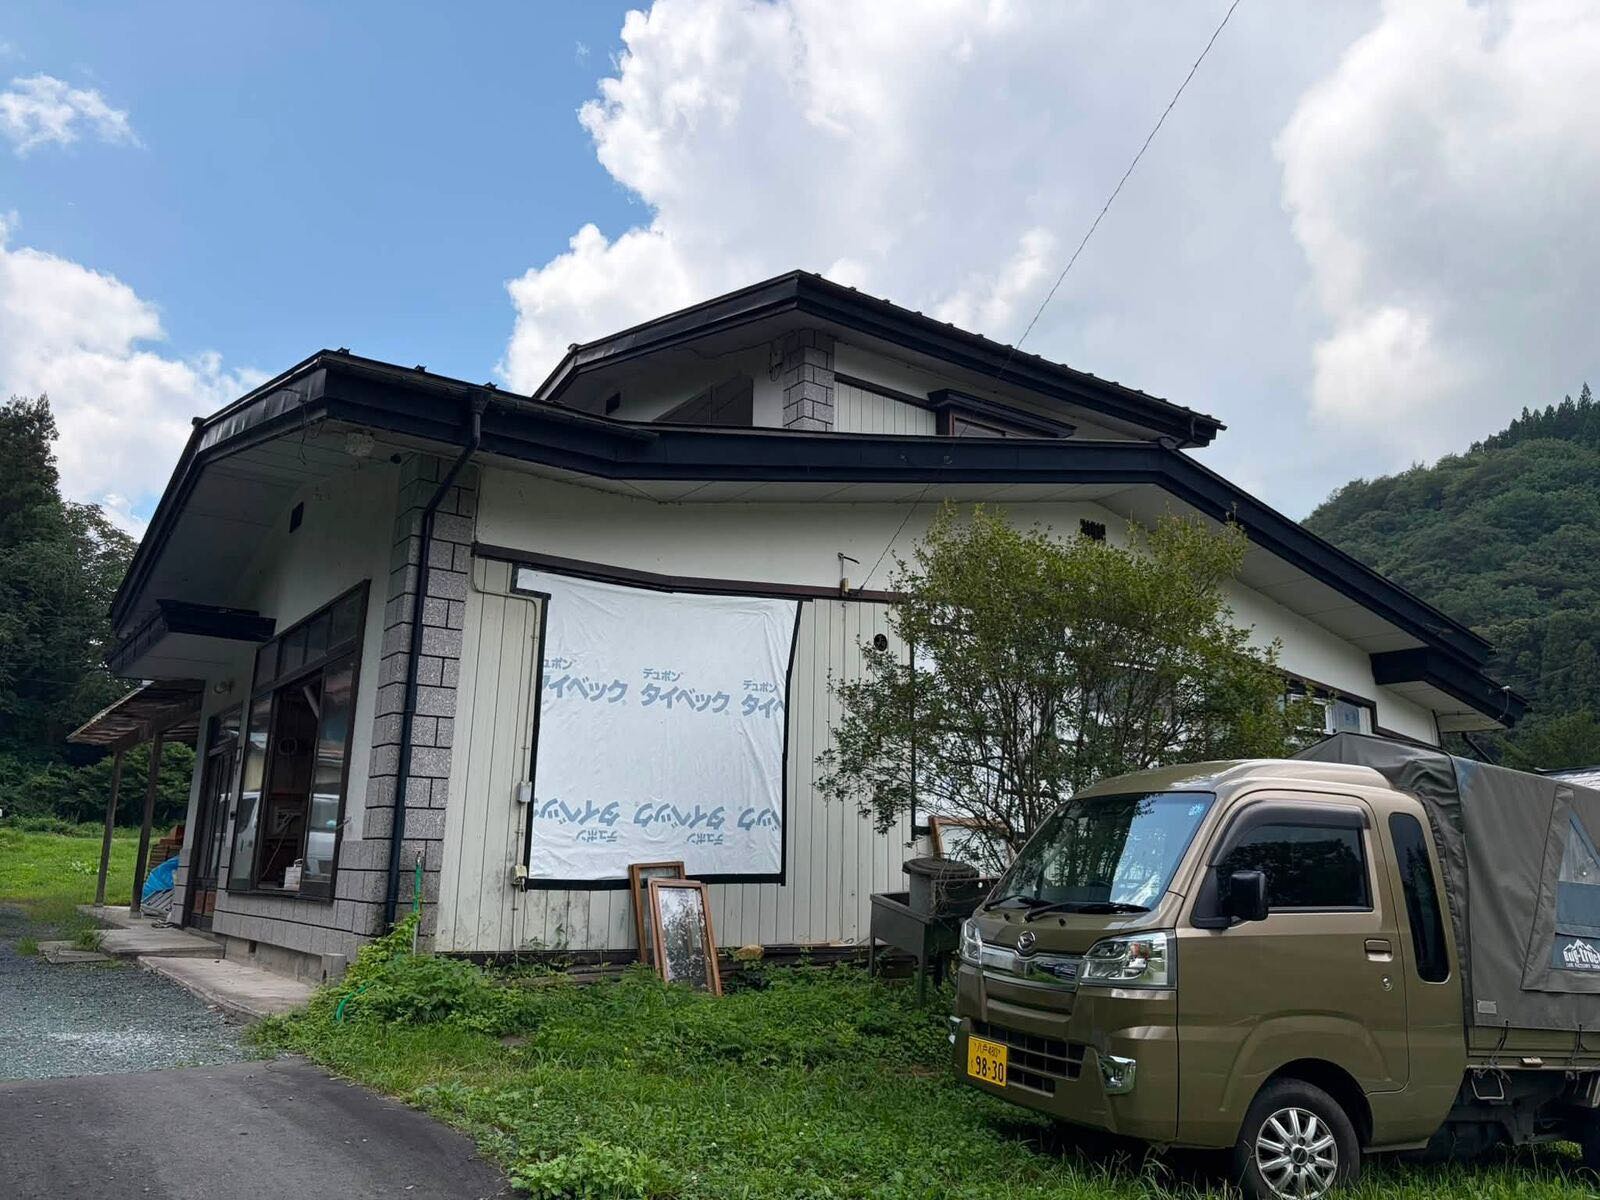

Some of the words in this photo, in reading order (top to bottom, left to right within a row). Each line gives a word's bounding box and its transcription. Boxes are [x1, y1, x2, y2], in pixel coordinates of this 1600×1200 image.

[643, 668, 681, 682] デュポン
[743, 680, 778, 693] デュポン
[640, 683, 730, 713] タイベック
[533, 798, 620, 827] タイベッ
[633, 802, 726, 830] タイベック
[576, 830, 618, 843] デュポン
[687, 832, 724, 846] デュポン
[976, 1056, 1004, 1082] 98-30
